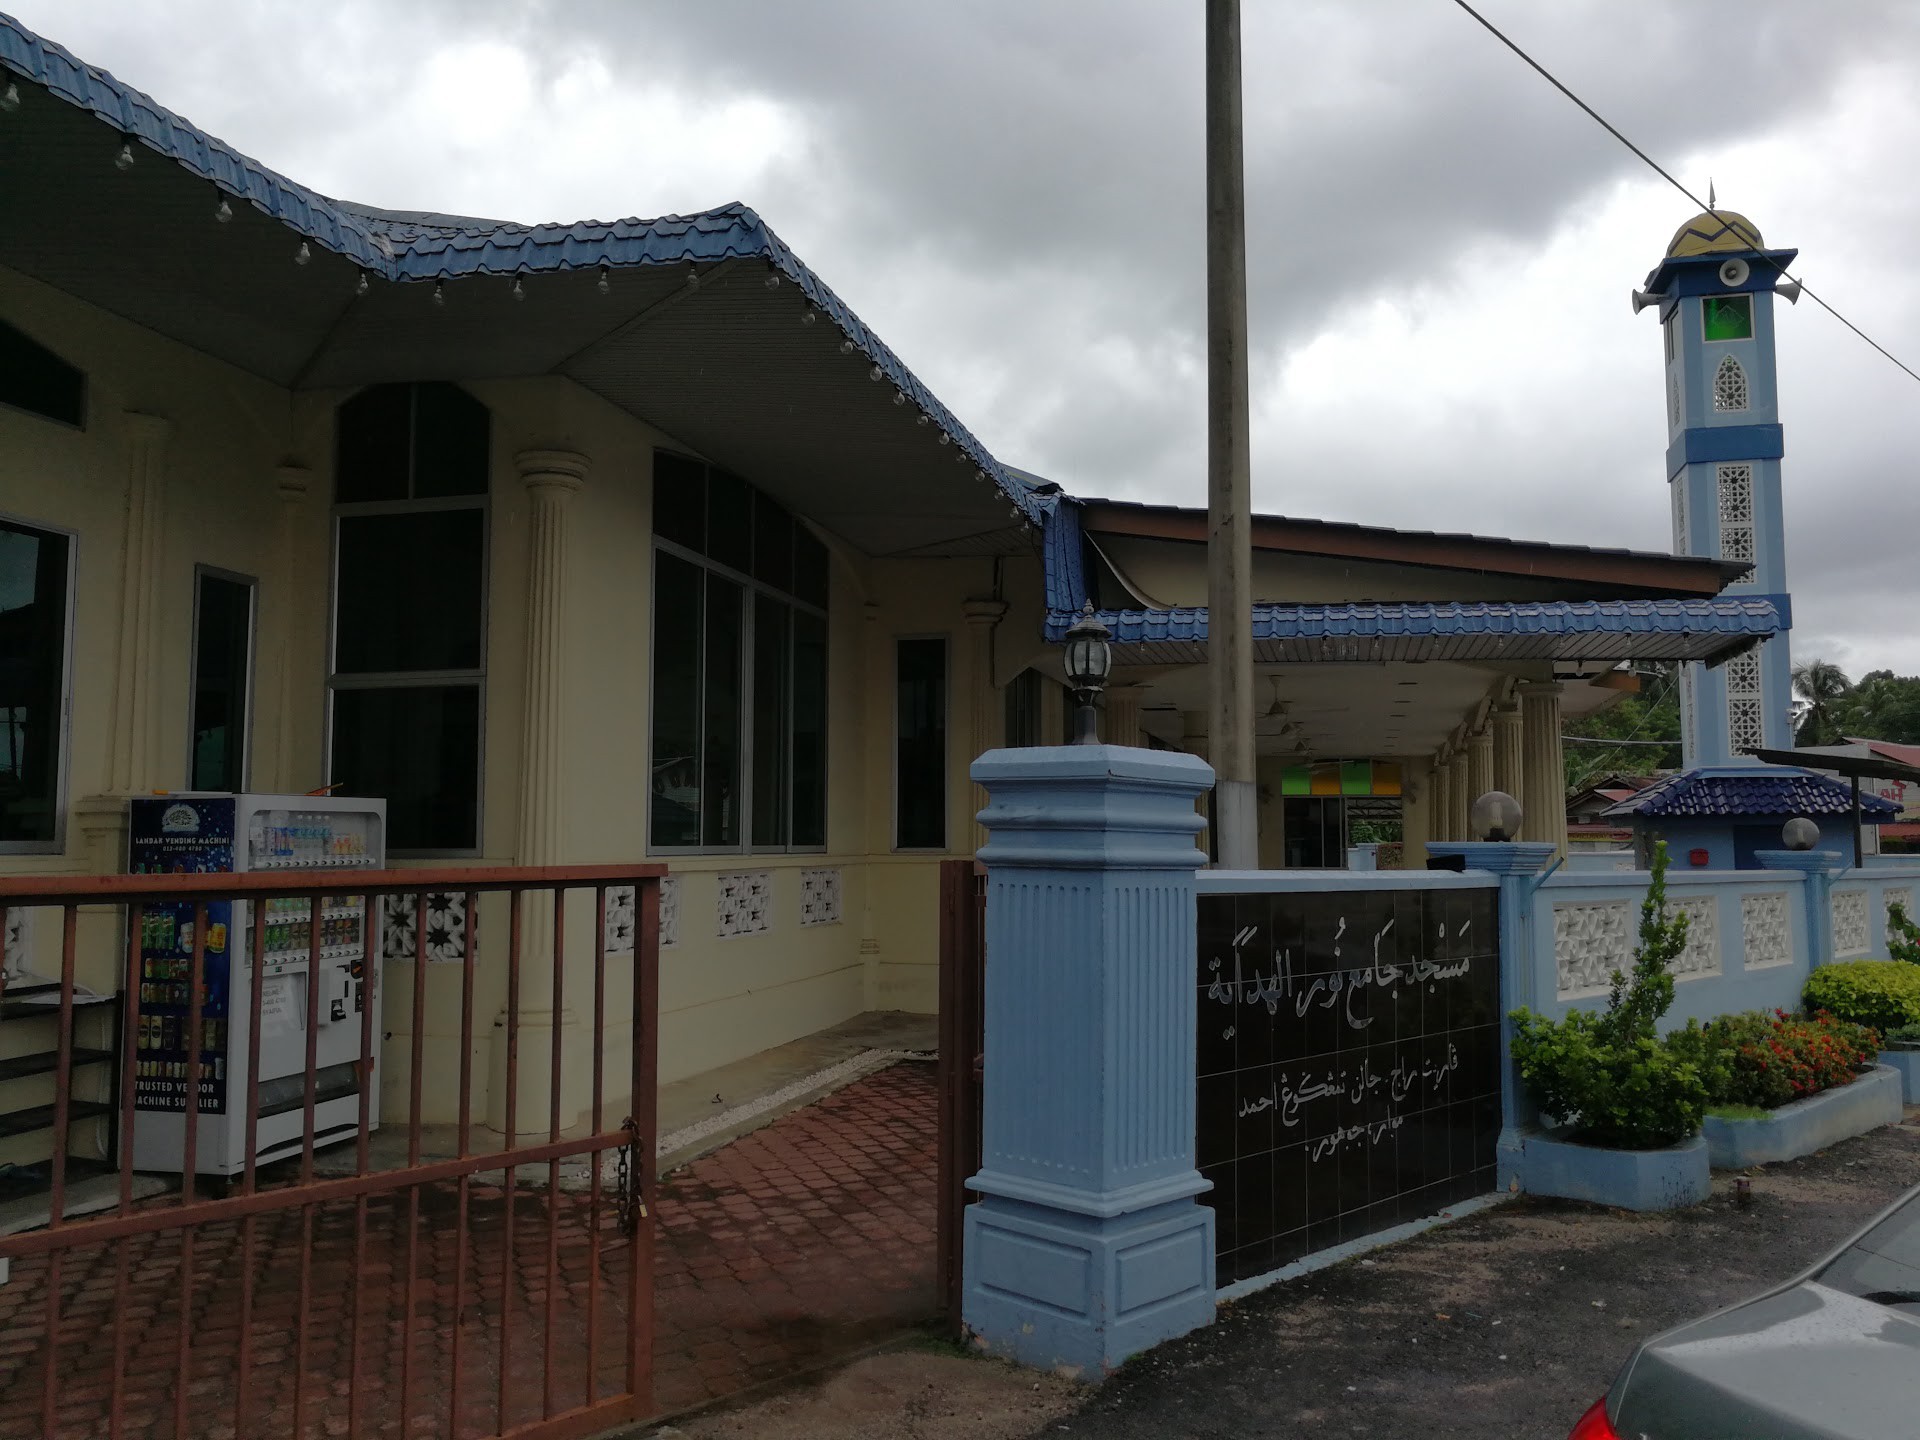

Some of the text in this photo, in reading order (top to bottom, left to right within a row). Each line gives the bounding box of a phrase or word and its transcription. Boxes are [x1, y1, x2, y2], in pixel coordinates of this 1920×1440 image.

[165, 836, 197, 845] VENDING
[135, 1081, 214, 1093] TRUSTED VEOR
[135, 1096, 219, 1108] ACHINE SULIER
